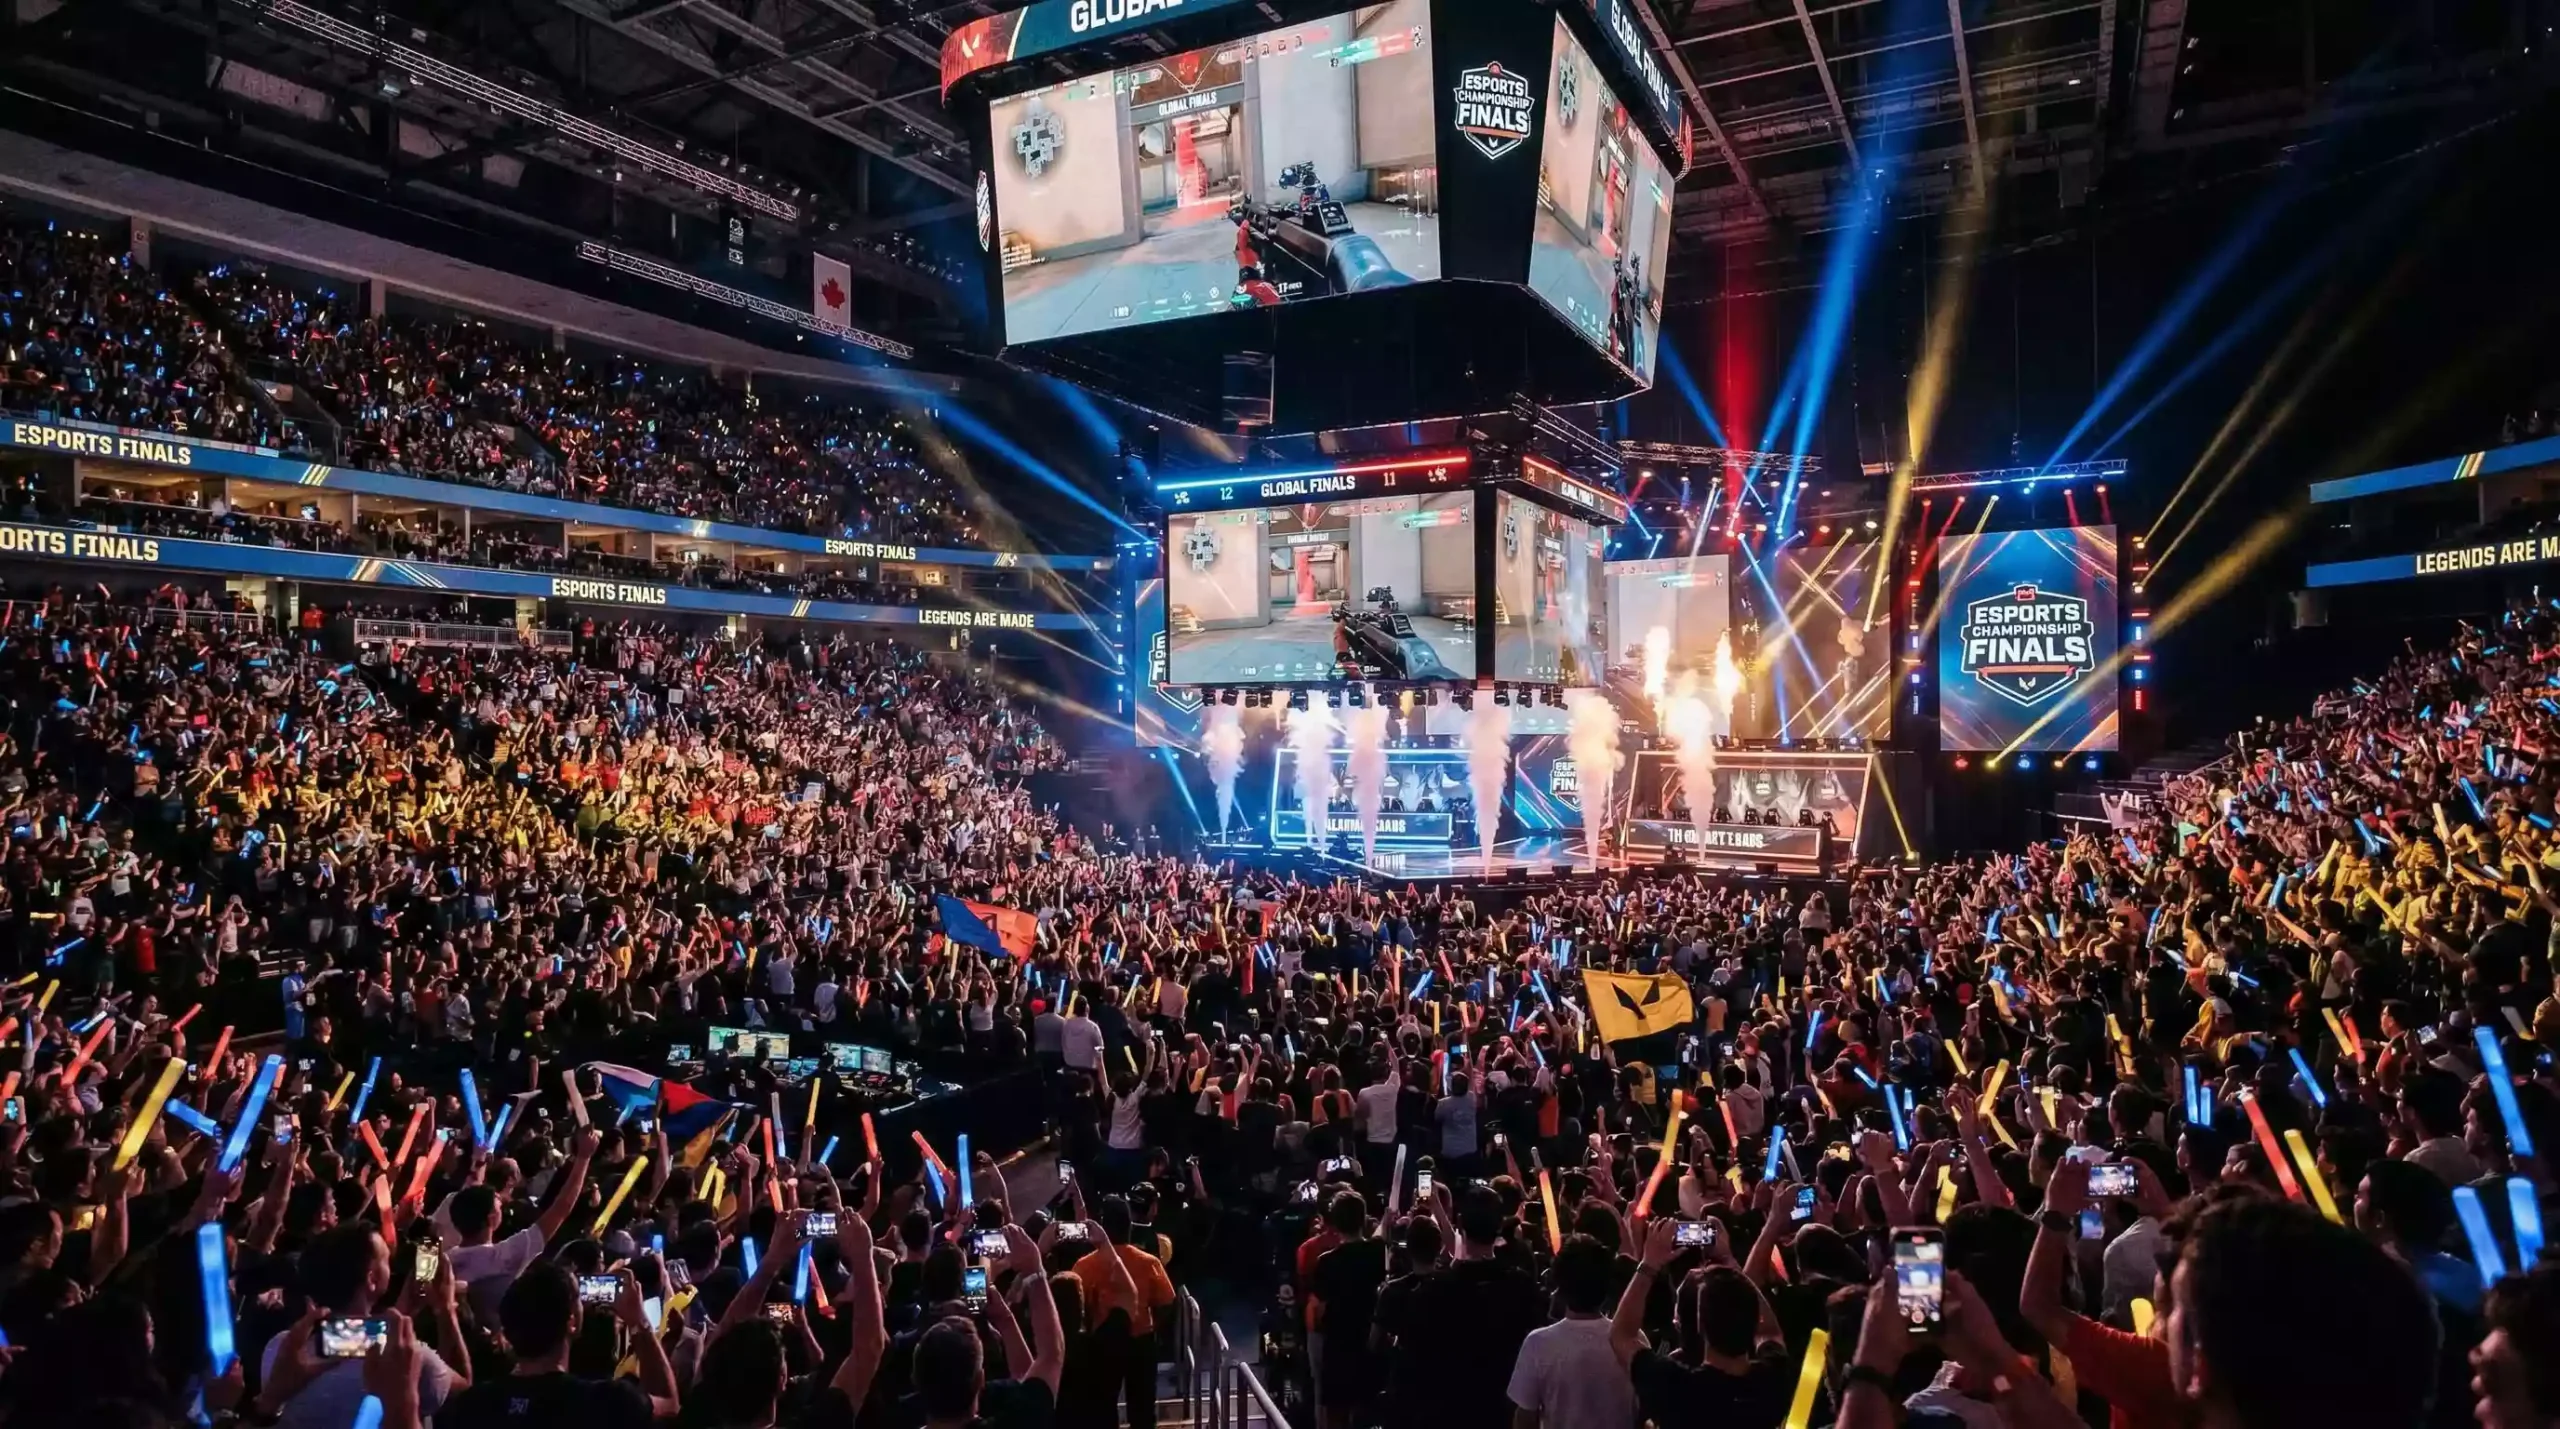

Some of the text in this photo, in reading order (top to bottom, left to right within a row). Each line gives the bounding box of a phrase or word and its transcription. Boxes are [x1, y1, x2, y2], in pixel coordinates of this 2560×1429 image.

[1465, 74, 1525, 96] ESPORTS
[1458, 90, 1530, 110] CHAMPIONSHIP
[1458, 103, 1528, 133] FINALS
[14, 423, 191, 466] ESPORTS FINALS
[1220, 487, 1233, 501] 12
[1261, 475, 1356, 498] GLOBAL FINALS
[73, 533, 159, 562] FINALS
[825, 539, 916, 561] ESPORTS FINALS
[2416, 546, 2495, 574] LEGENDS
[2500, 540, 2536, 565] ARE
[552, 579, 666, 605] ESPORTS FINALS
[919, 609, 1035, 628] LEGENDS ARE MADE
[1975, 604, 2080, 625] ESPORTS
[1972, 623, 2082, 638] CHAMPIONSHIP
[1968, 636, 2088, 664] FINALS
